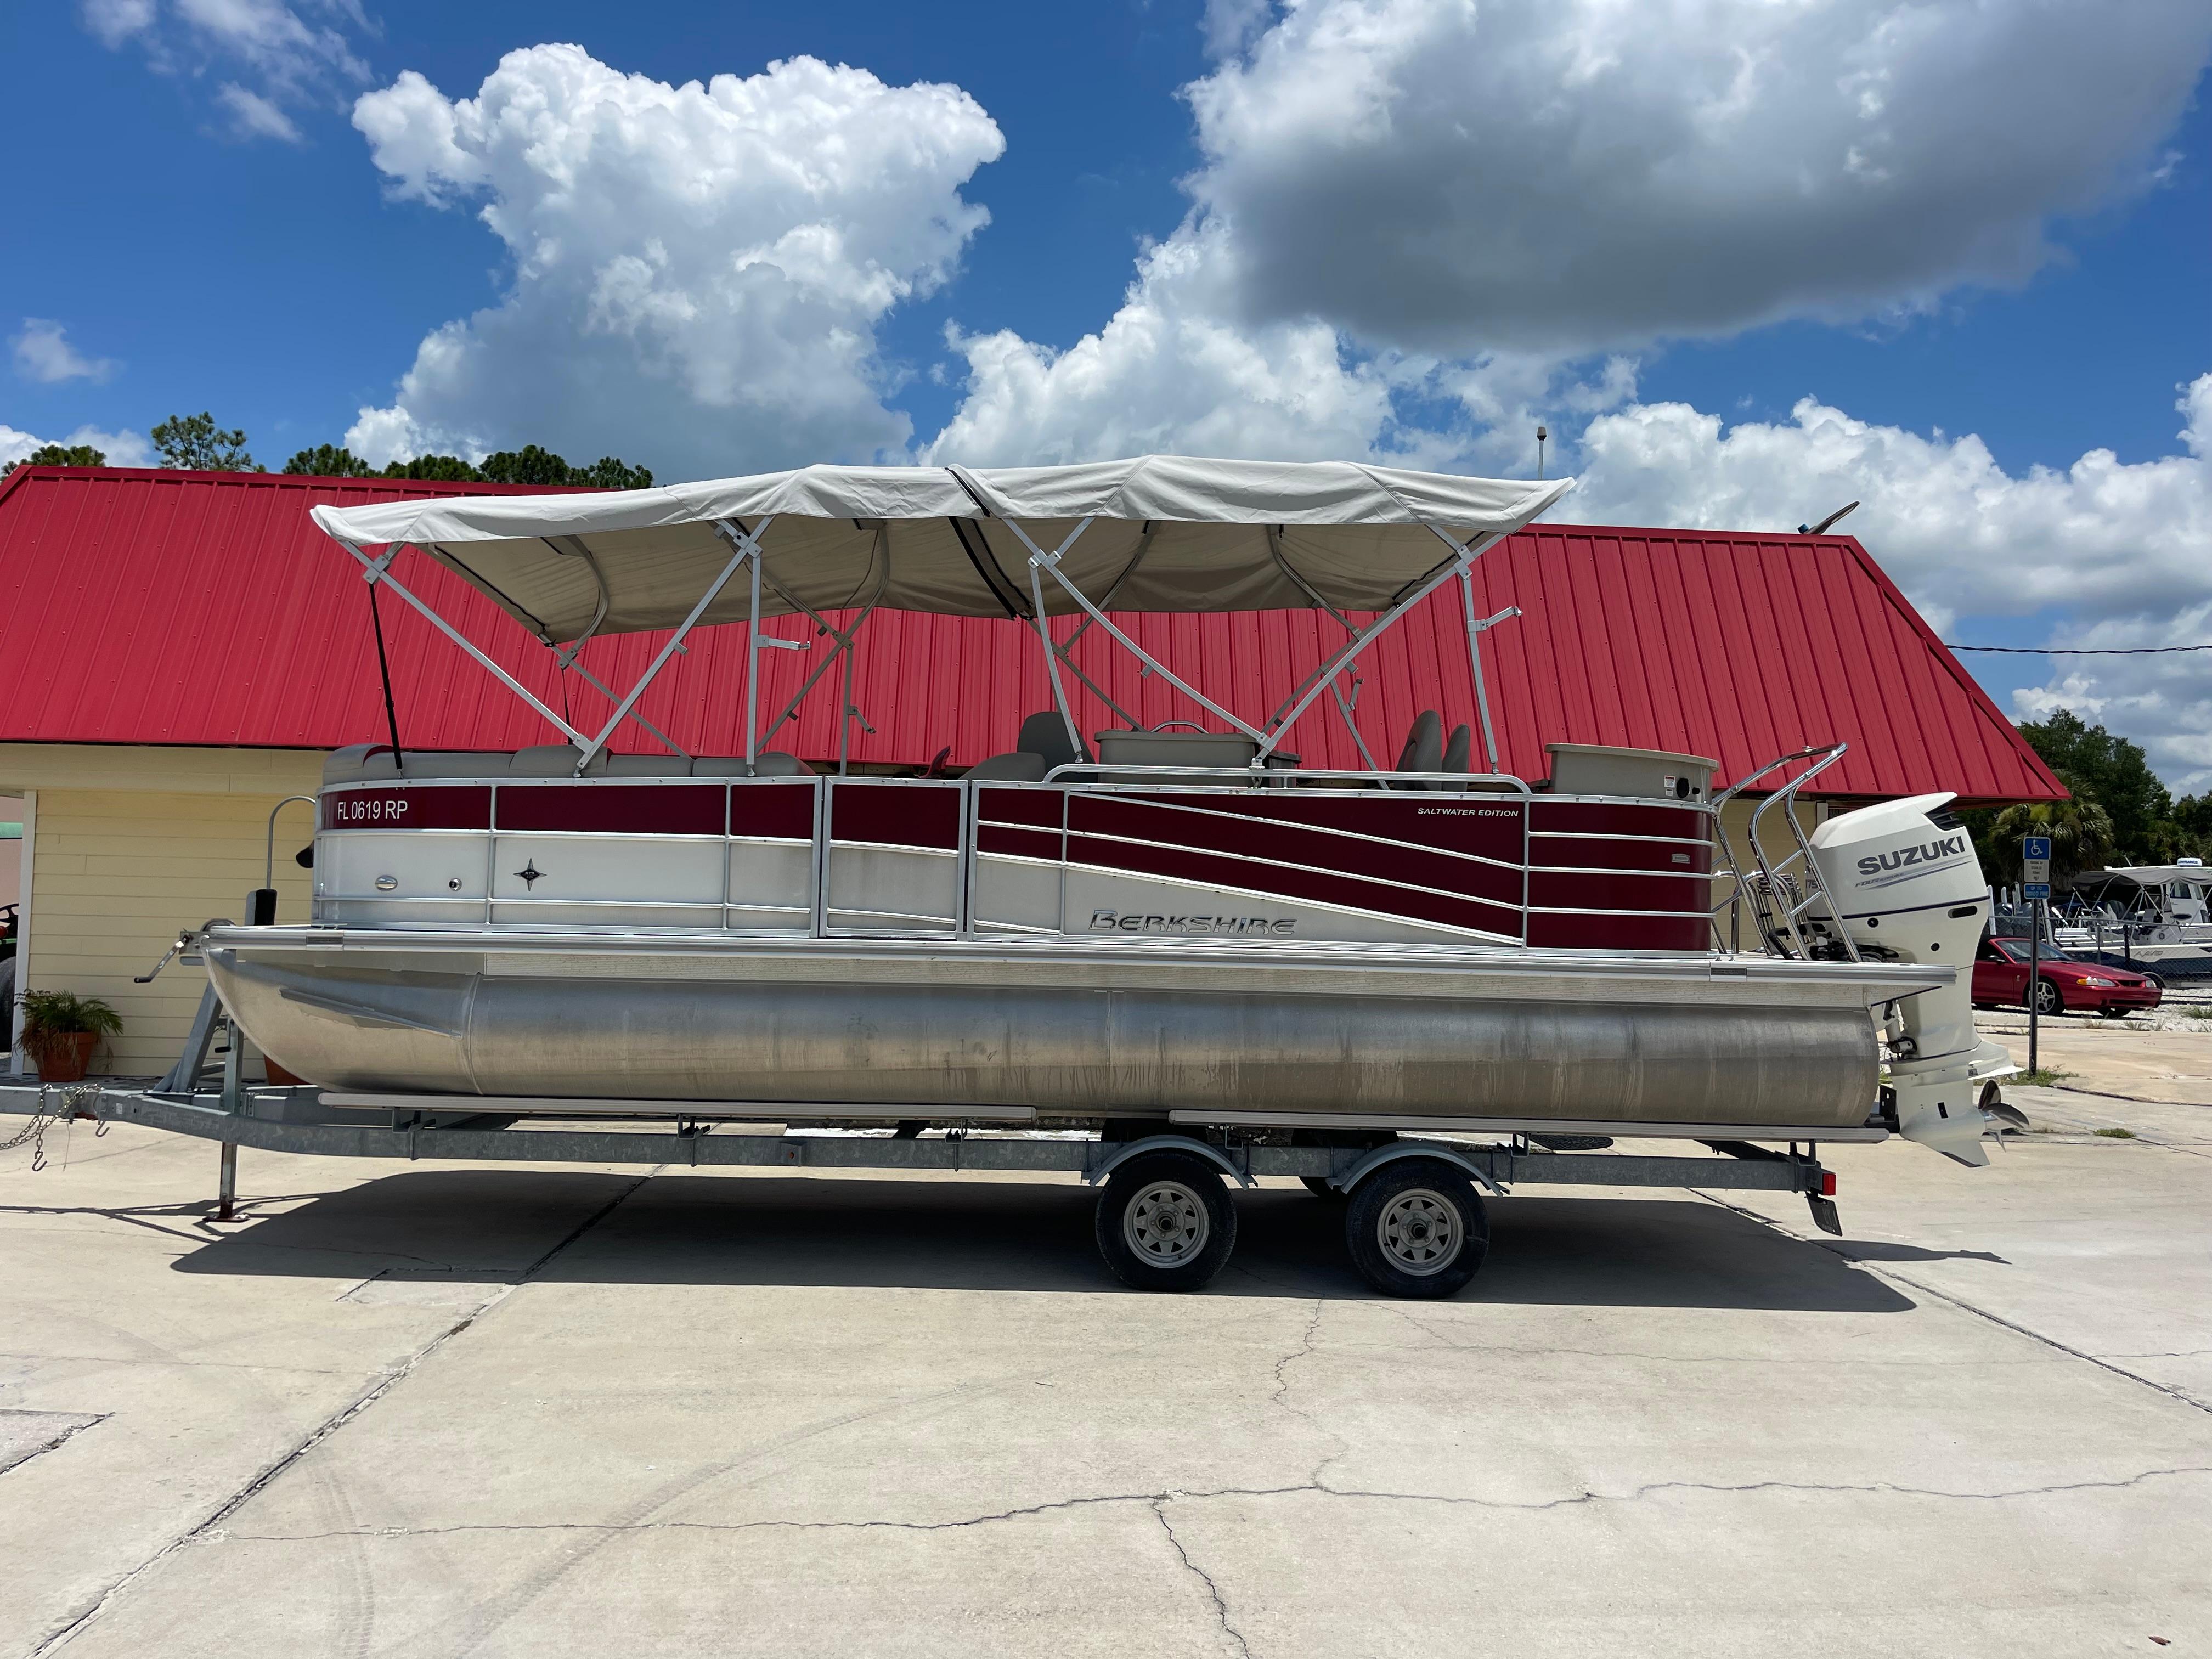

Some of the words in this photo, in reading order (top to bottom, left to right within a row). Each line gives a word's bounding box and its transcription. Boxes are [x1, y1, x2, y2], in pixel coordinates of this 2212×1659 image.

[337, 802, 349, 820] FL
[351, 800, 381, 820] 0619
[385, 800, 408, 819] RP
[1417, 808, 1476, 816] SALTWATER
[1857, 836, 1966, 876] SUZUKI
[1088, 909, 1297, 935] BERKSHIRE
